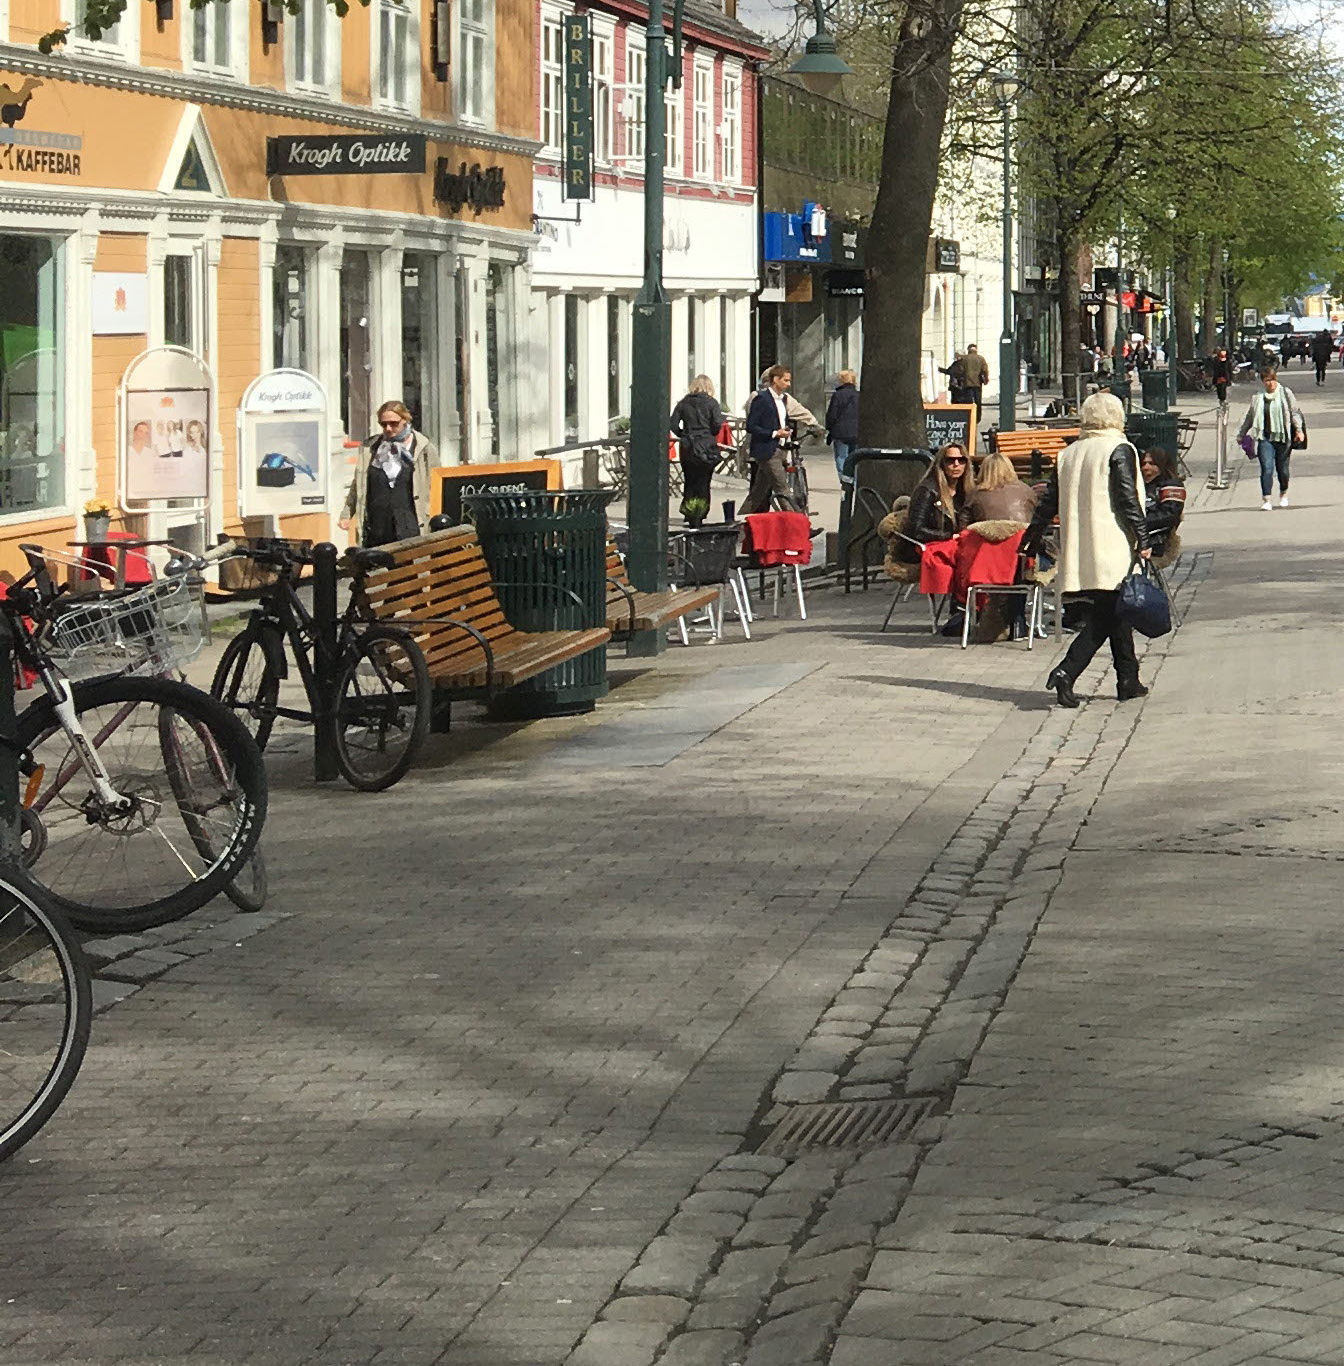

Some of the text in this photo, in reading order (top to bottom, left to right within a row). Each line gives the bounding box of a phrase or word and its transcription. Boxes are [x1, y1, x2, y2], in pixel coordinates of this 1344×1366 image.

[571, 24, 585, 186] BRILLER
[16, 149, 81, 176] KAFFEBAR
[288, 141, 411, 168] Krogh Optikk
